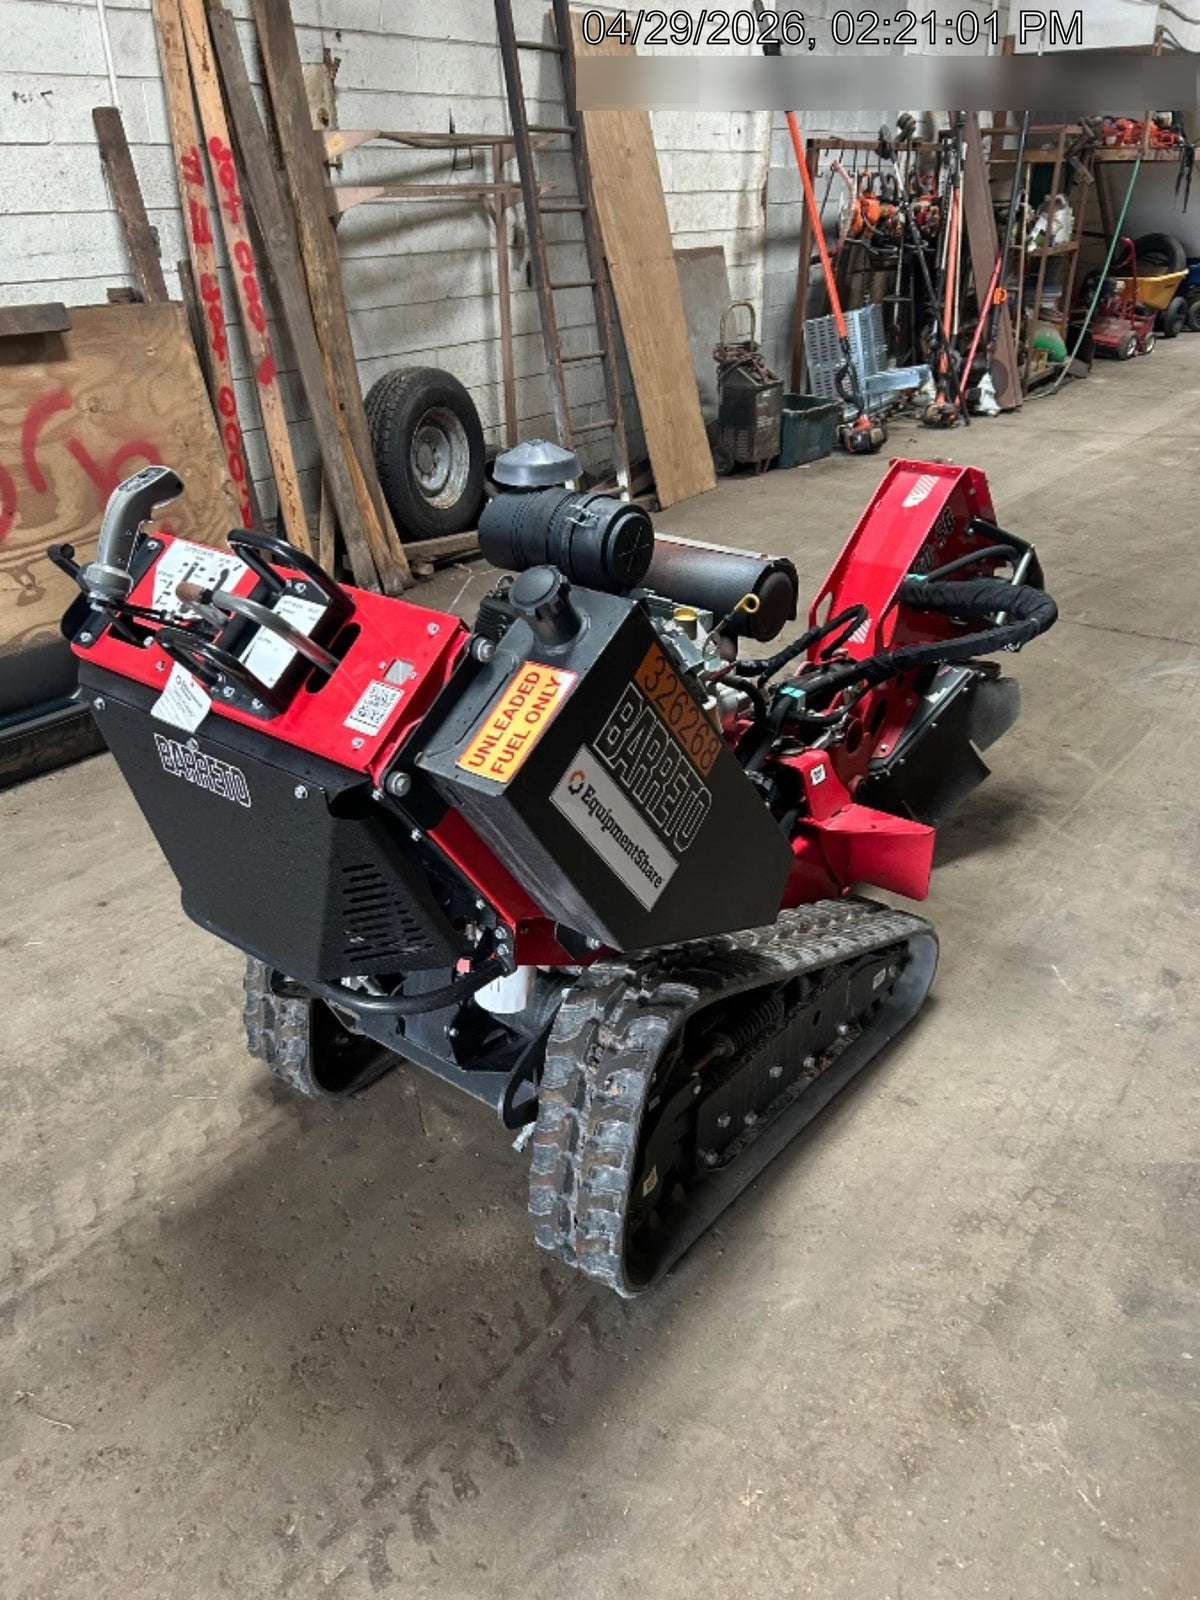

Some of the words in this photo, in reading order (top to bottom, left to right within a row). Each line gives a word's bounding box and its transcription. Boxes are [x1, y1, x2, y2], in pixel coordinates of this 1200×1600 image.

[467, 670, 542, 768] UNLEADED
[490, 724, 531, 774] FUEL
[523, 675, 562, 725] ONLY
[643, 654, 719, 773] 326268
[154, 733, 252, 808] BARRETO
[593, 681, 712, 852] BARRETO
[580, 782, 665, 890] EquipmentShare
